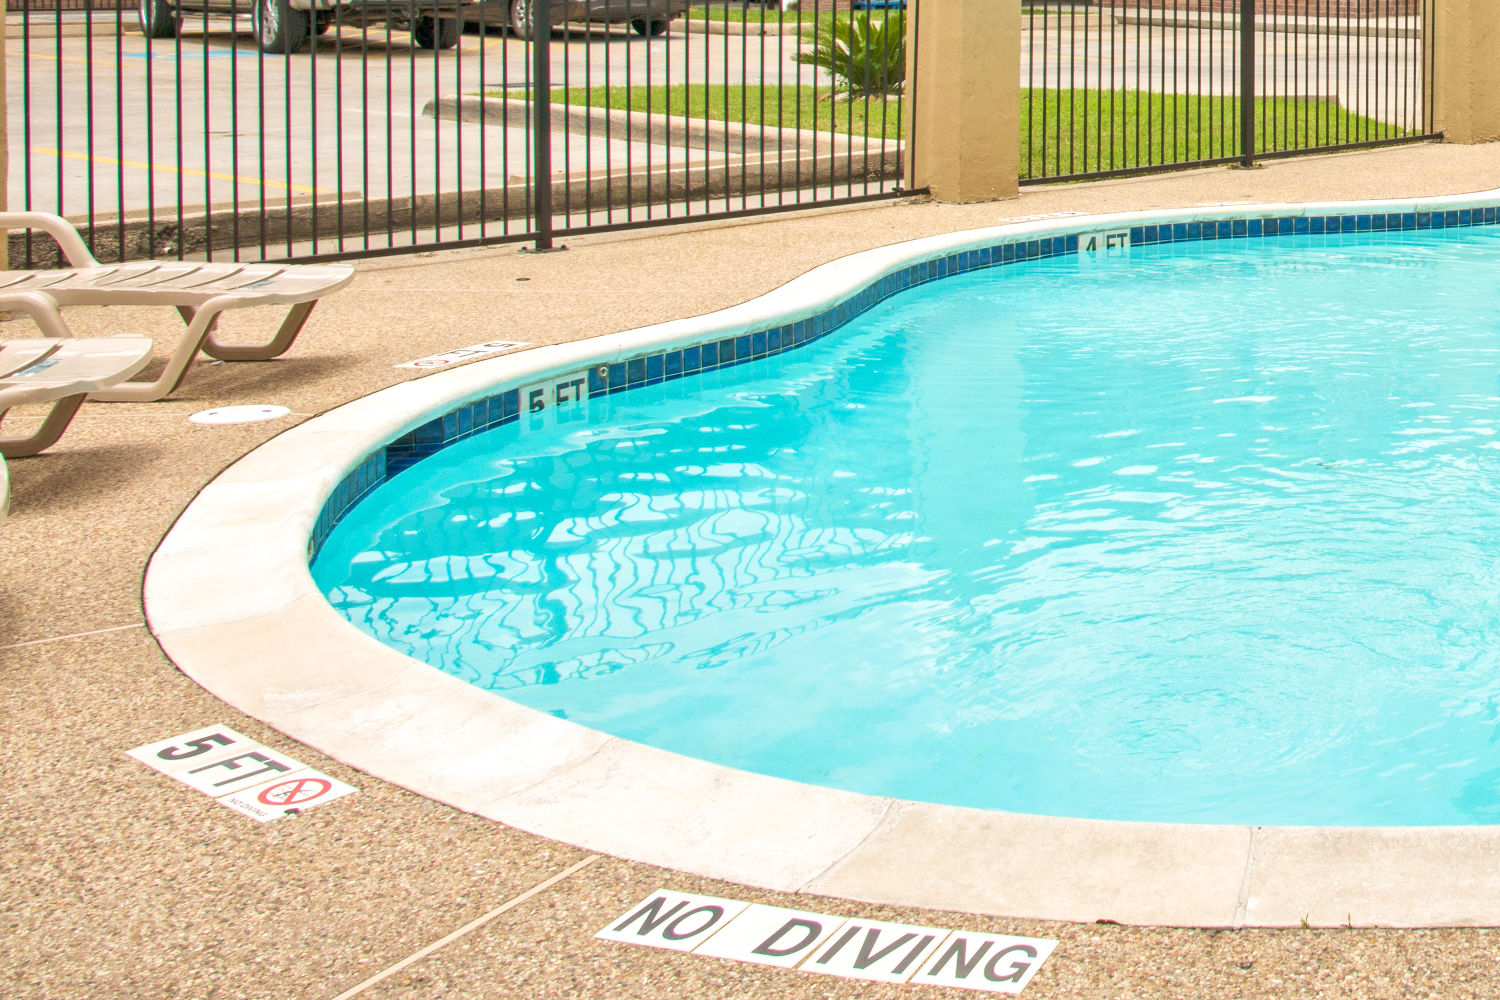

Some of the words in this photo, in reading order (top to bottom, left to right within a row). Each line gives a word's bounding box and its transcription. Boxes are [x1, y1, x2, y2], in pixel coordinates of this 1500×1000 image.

[529, 388, 544, 413] 5
[556, 377, 585, 406] FT
[156, 733, 237, 761] 5
[187, 751, 292, 787] FT
[613, 896, 724, 941] NO
[751, 918, 1038, 983] DIVING
